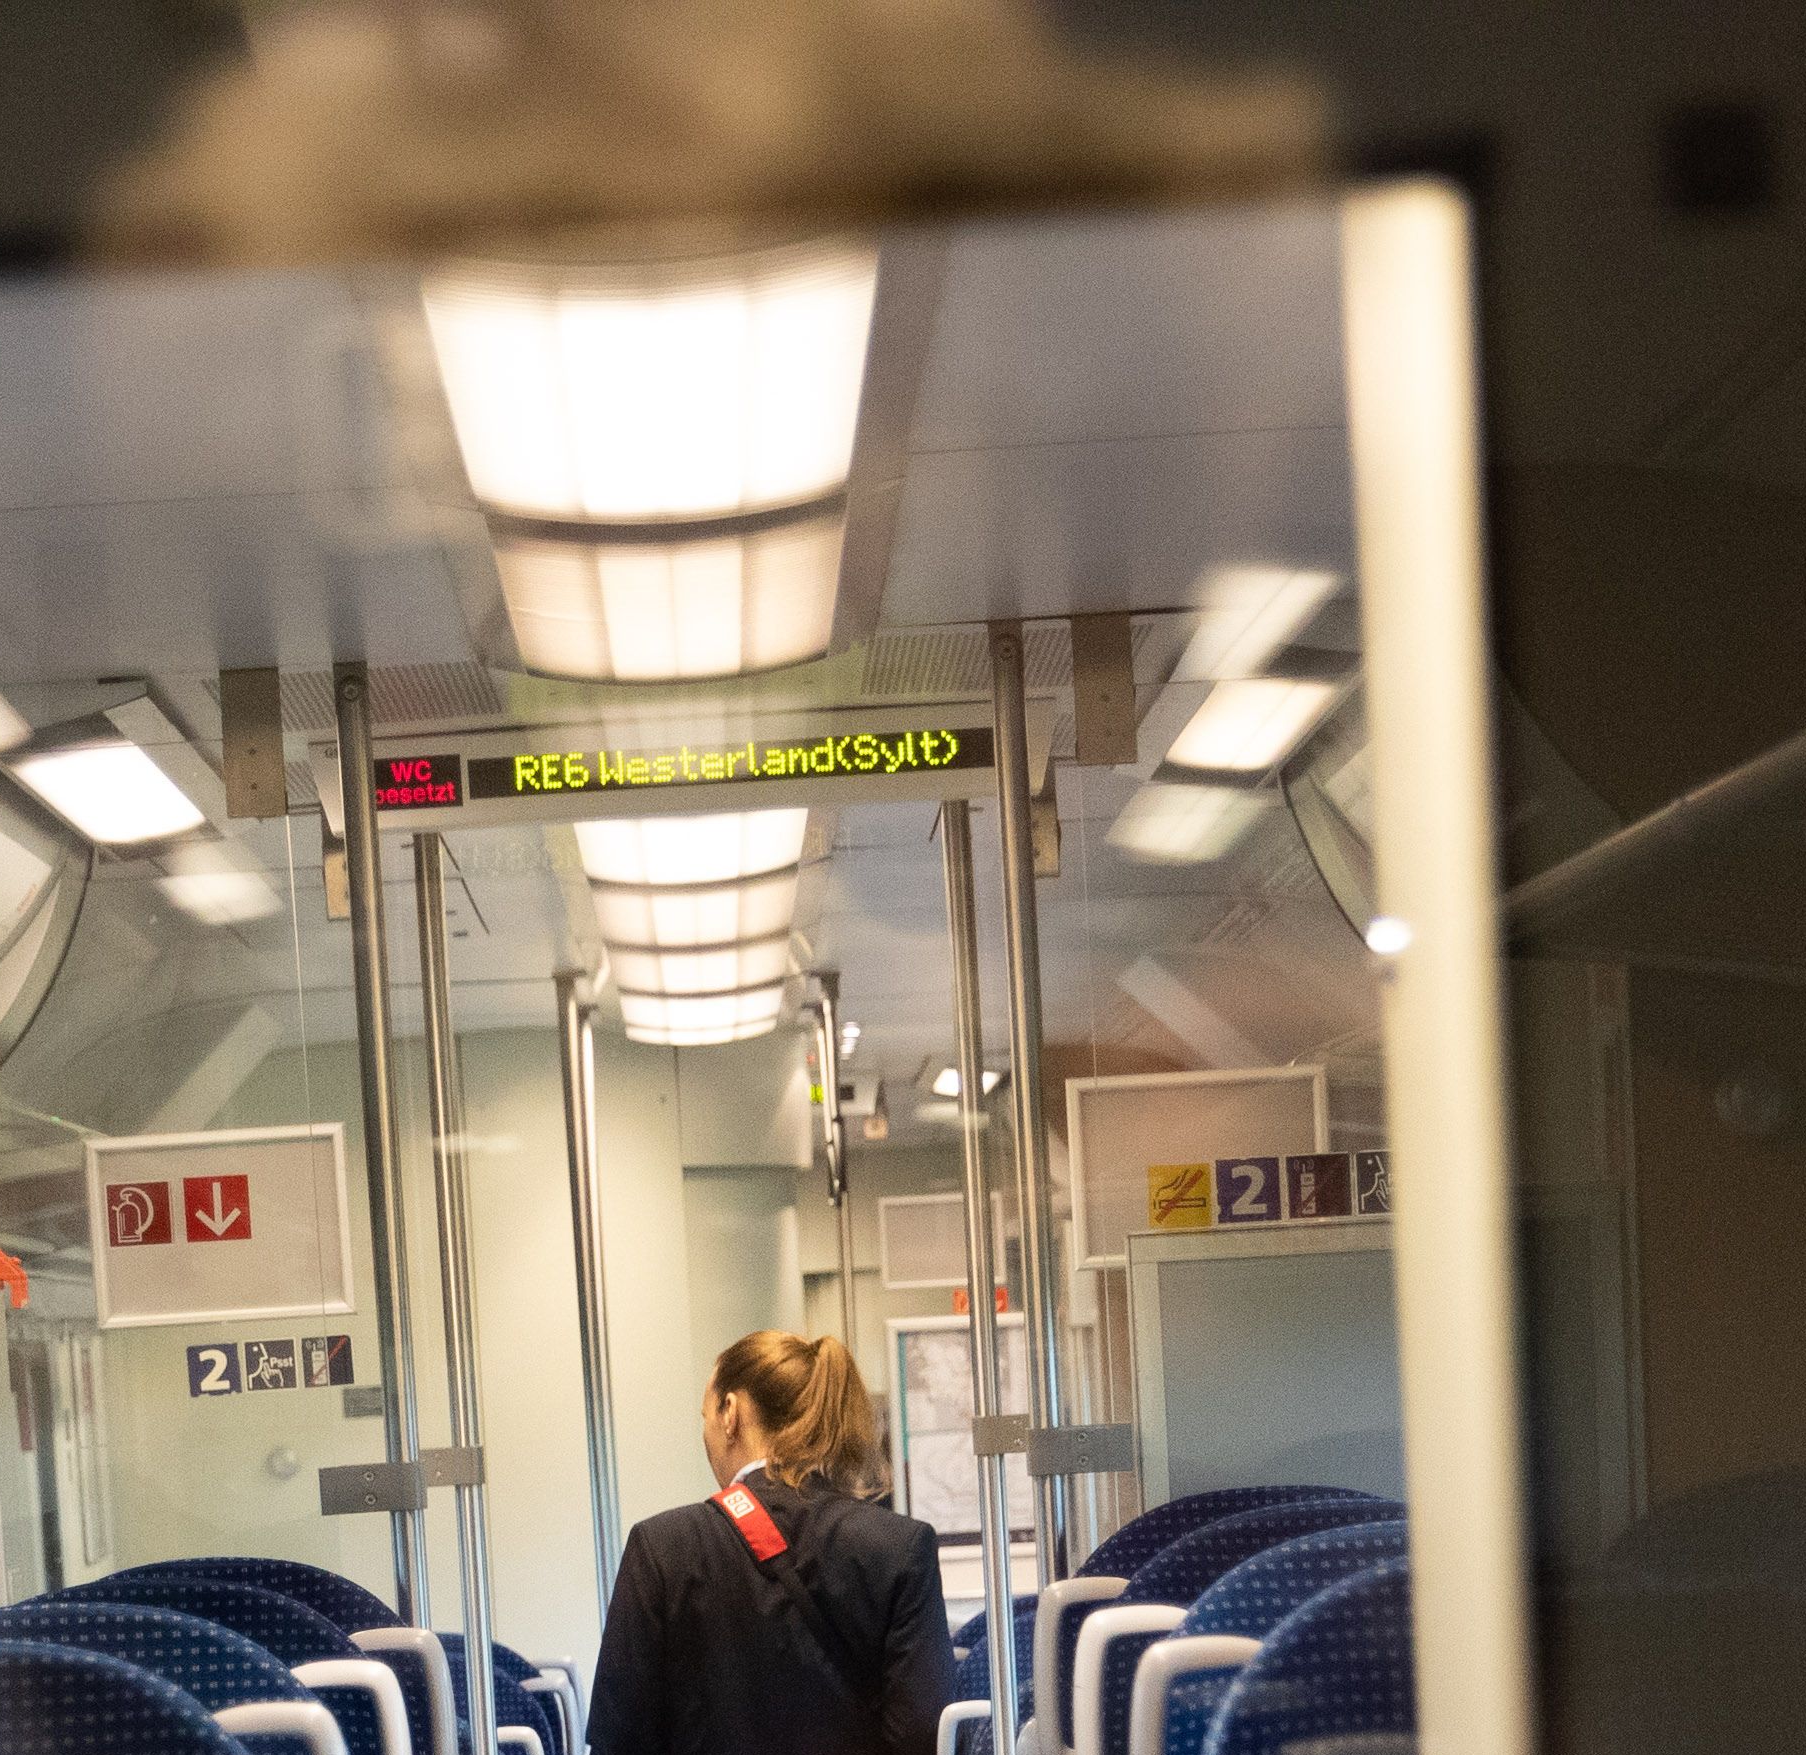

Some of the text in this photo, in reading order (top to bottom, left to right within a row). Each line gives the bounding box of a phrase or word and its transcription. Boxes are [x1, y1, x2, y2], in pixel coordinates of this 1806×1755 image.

[389, 759, 432, 783] WC
[514, 729, 959, 792] RE6 Westerland(Sylt)
[1230, 1164, 1268, 1216] 2
[198, 1348, 231, 1392] 2
